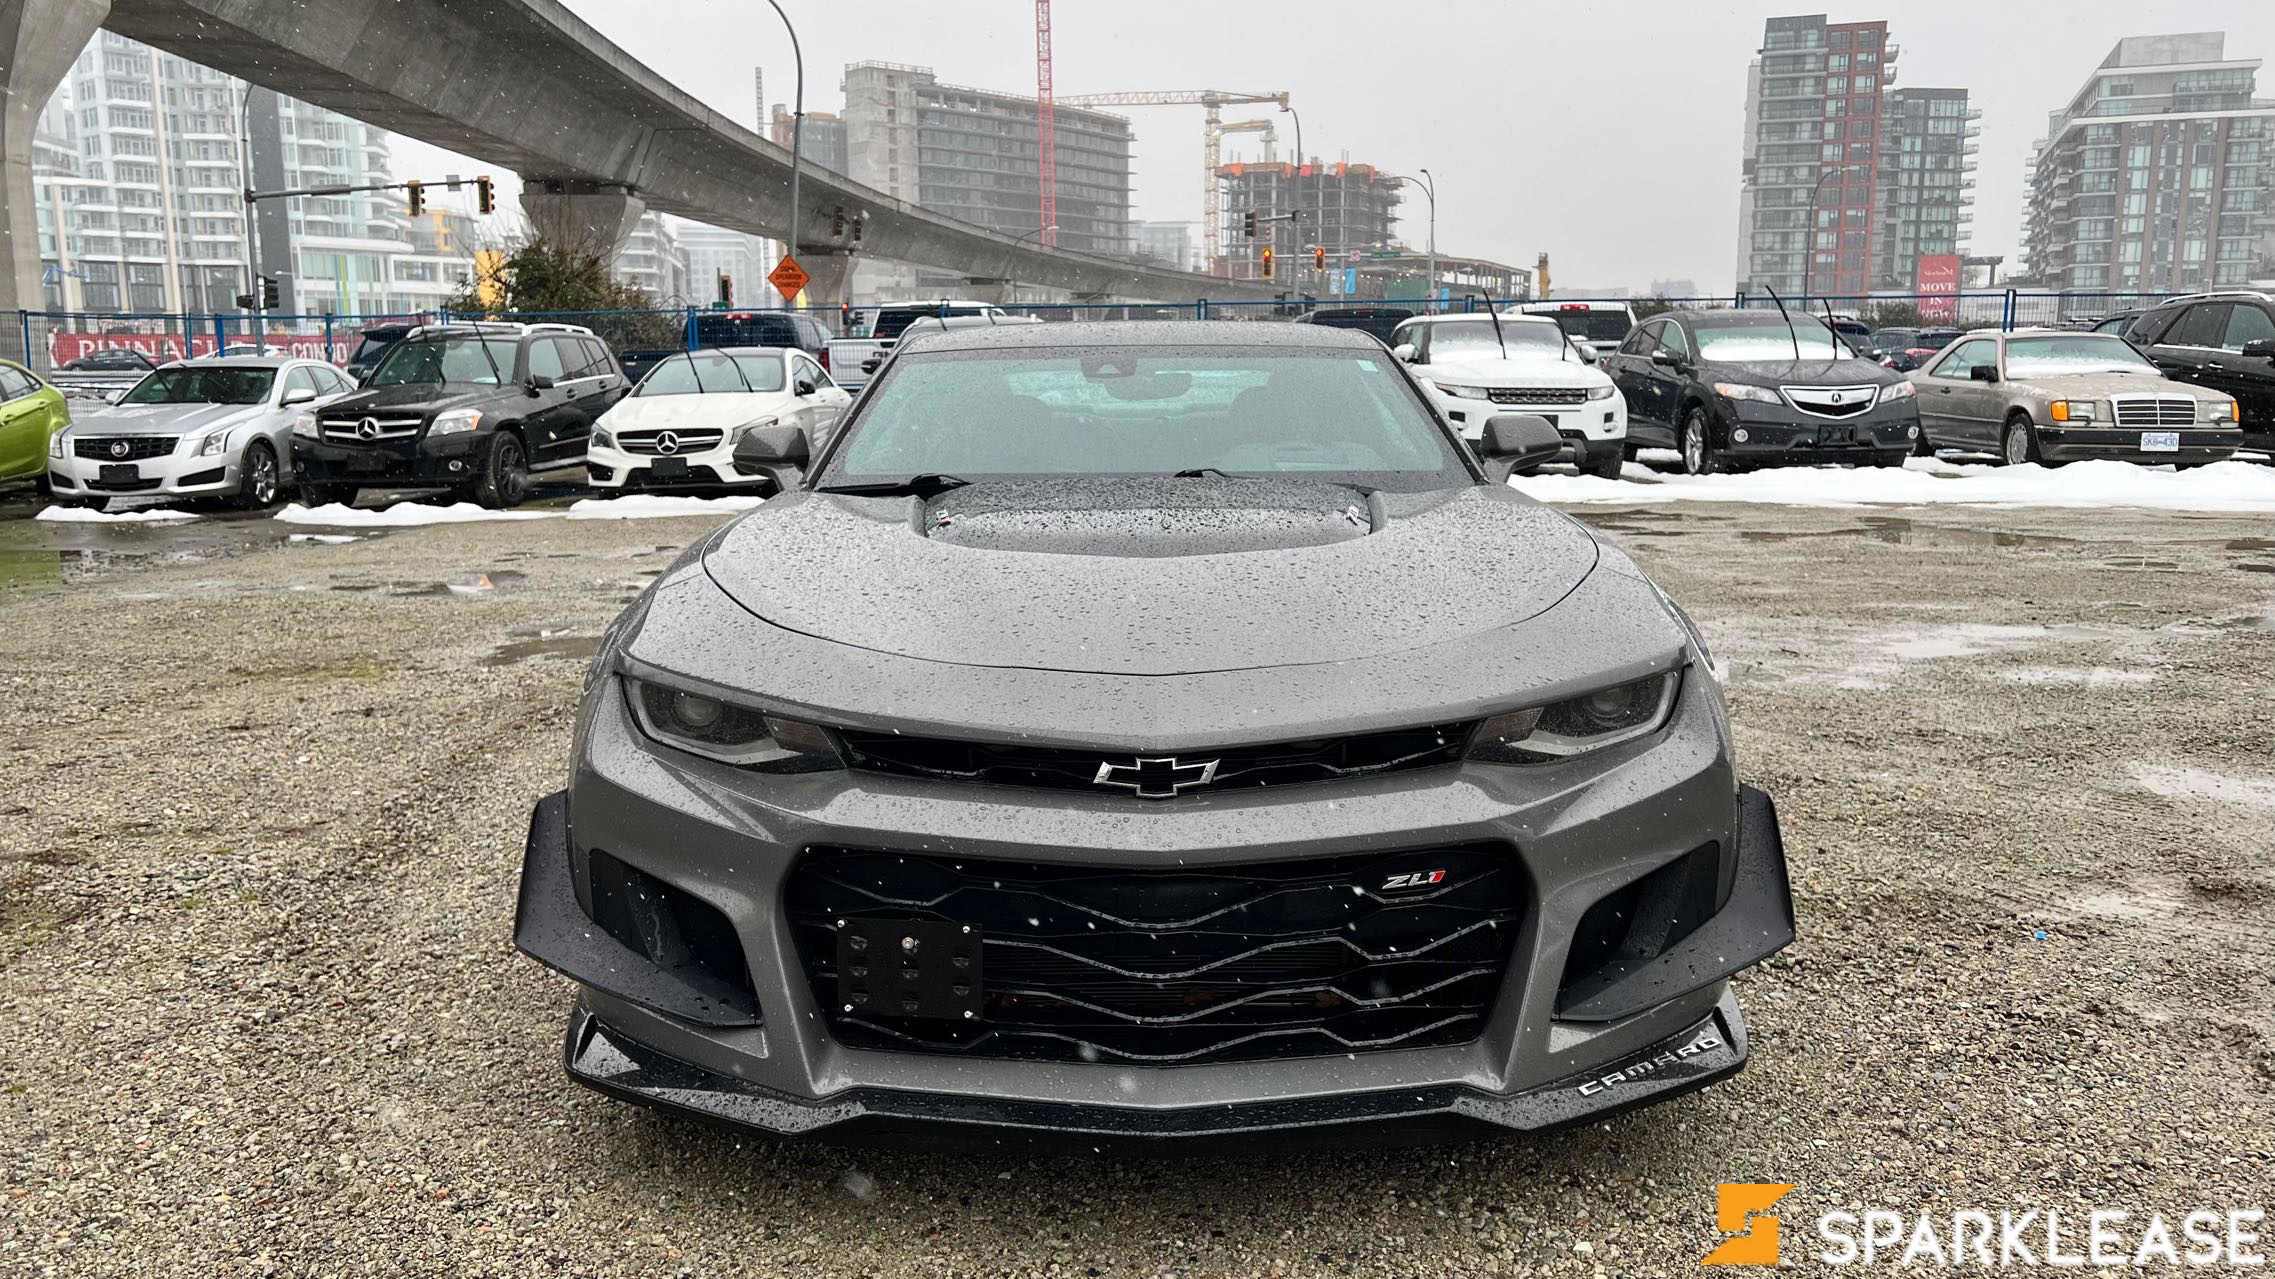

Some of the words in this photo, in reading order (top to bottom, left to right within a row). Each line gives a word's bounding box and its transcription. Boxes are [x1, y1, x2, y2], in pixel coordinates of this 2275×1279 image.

[1920, 282, 1956, 292] MOVE
[1382, 870, 1446, 889] ZL1
[1578, 1037, 1720, 1096] CAMARO
